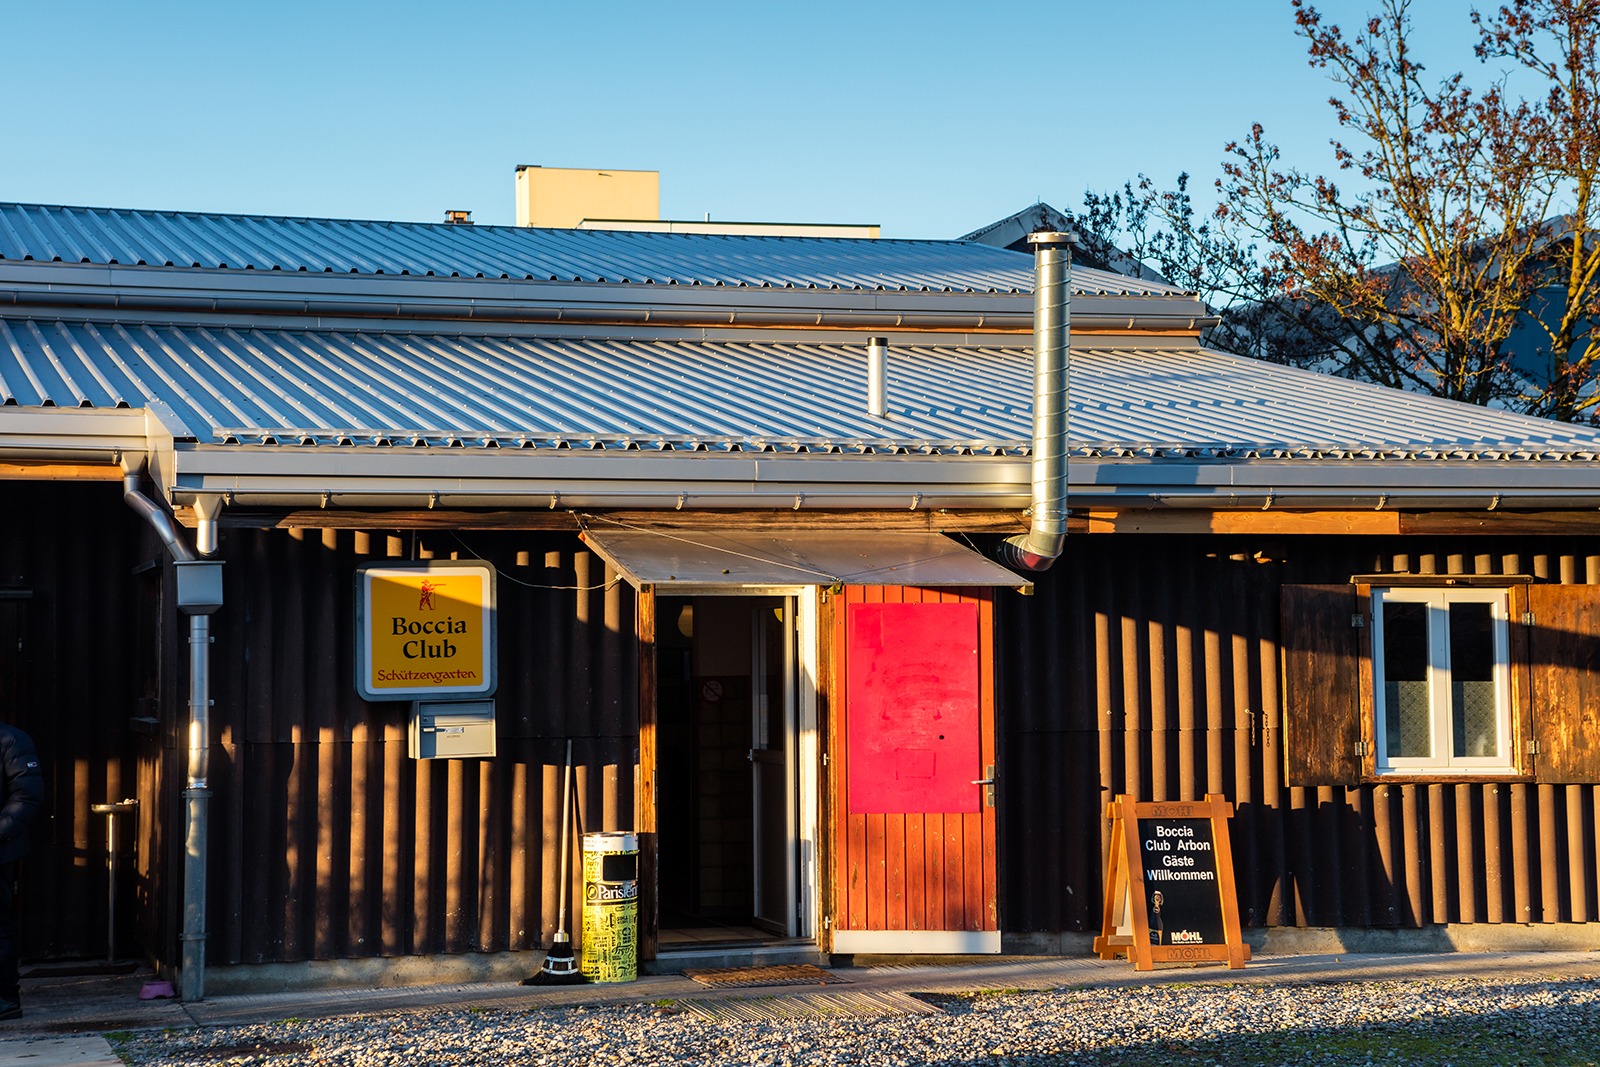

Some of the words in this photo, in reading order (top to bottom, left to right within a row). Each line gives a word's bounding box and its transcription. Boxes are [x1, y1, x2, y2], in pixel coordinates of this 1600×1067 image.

[392, 616, 467, 635] Boccia
[402, 639, 457, 659] Club
[377, 669, 476, 684] Schützengarten
[1156, 825, 1194, 837] Boccia
[1145, 839, 1171, 851] Club
[1177, 839, 1211, 851] Arbon
[1162, 855, 1195, 867] Gäste
[1147, 869, 1214, 881] Willkommen
